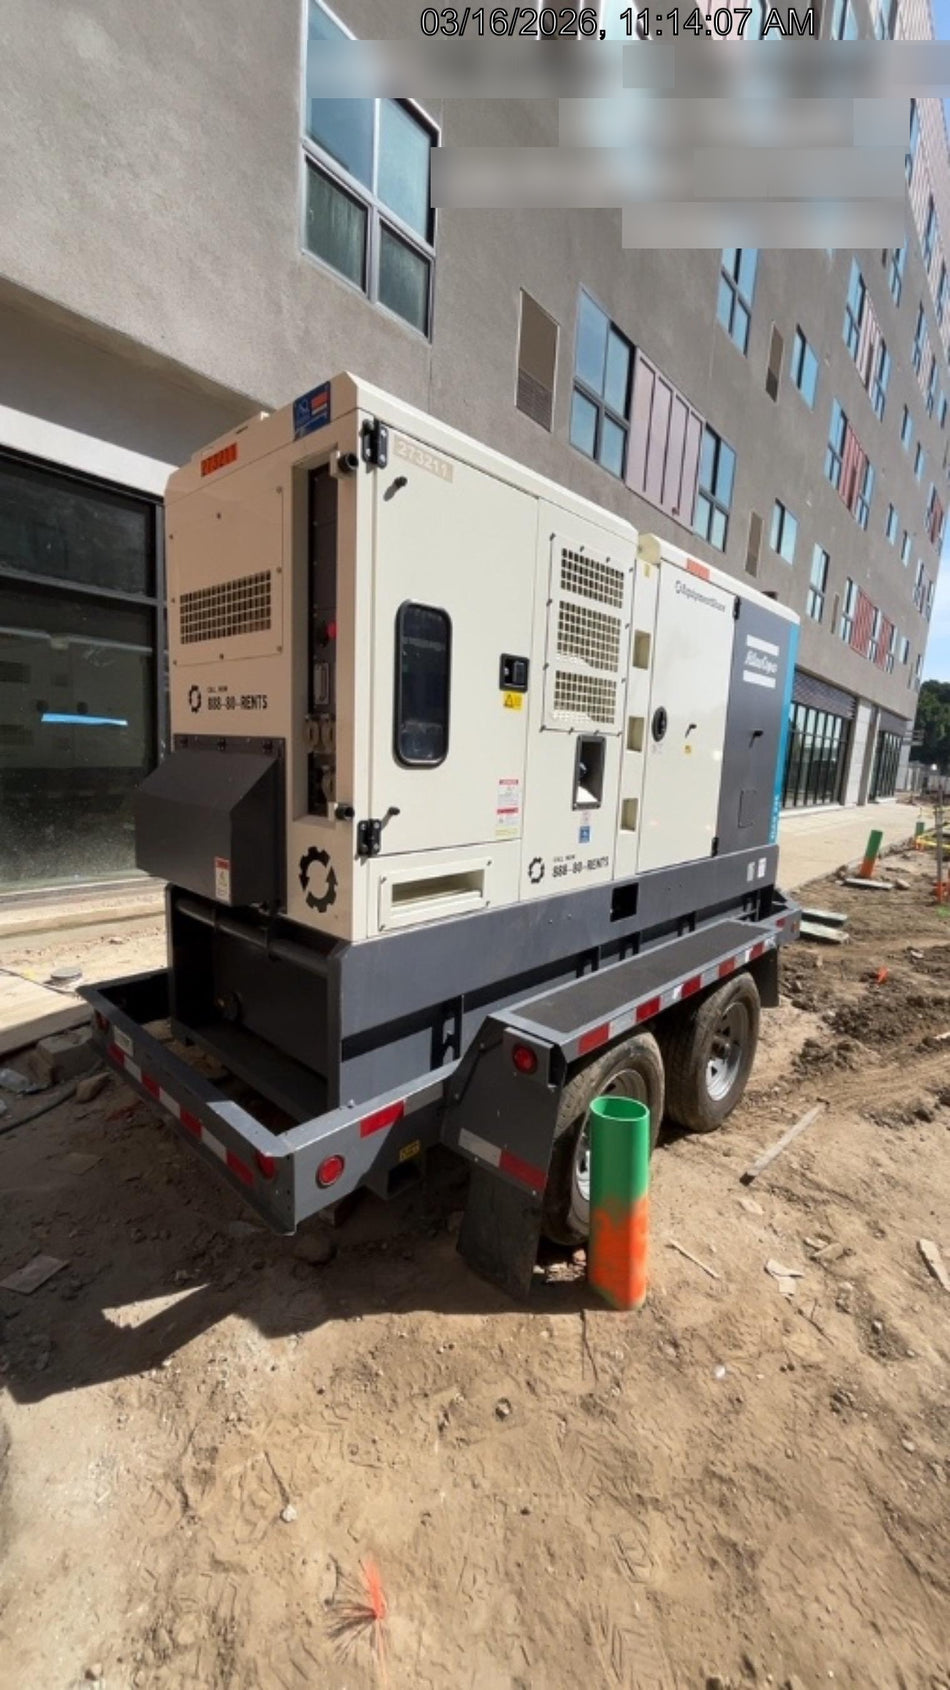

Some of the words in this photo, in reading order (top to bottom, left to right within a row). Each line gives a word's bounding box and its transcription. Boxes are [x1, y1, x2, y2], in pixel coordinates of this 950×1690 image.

[397, 438, 451, 480] 273211
[207, 694, 268, 711] 888-80-RENTS
[552, 855, 609, 878] 888-80-RENTS
